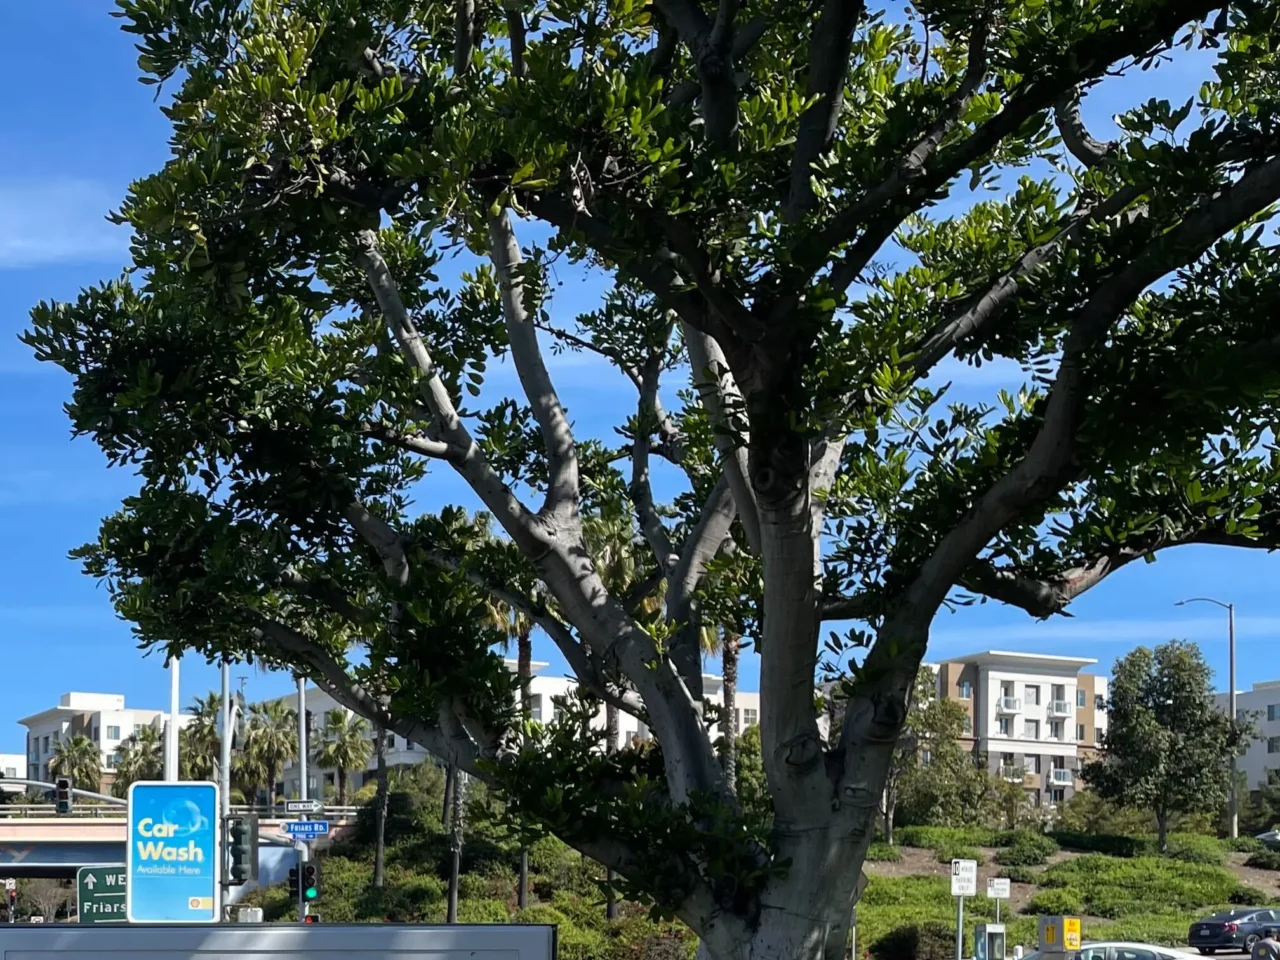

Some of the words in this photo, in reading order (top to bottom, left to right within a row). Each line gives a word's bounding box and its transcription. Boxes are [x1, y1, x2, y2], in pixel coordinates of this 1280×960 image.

[137, 818, 178, 837] Car
[137, 840, 204, 862] Wash
[137, 865, 175, 874] Available
[179, 865, 201, 874] Here
[83, 901, 126, 913] Friars
